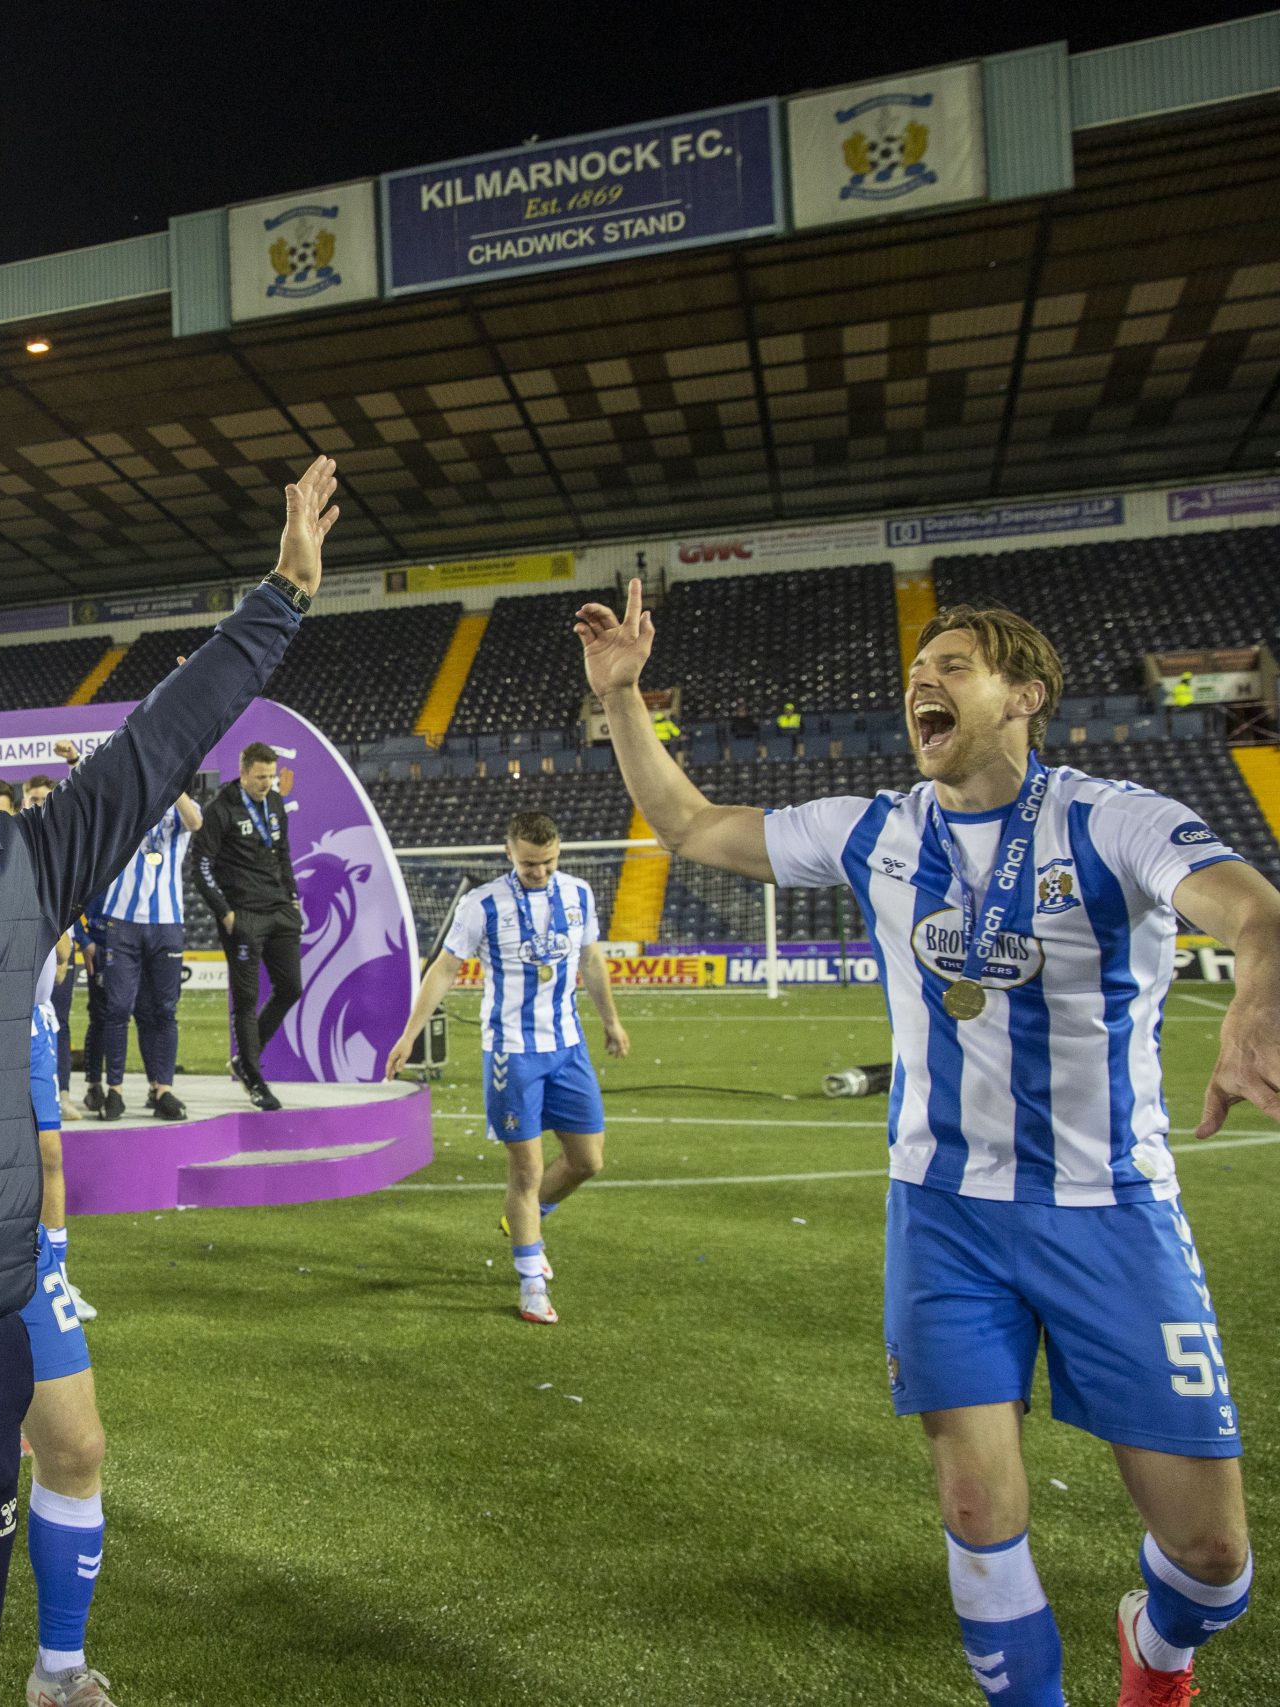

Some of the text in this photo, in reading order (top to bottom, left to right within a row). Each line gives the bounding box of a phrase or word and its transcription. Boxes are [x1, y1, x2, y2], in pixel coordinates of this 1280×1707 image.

[420, 128, 734, 212] KILMARNOCK F.C.
[523, 183, 625, 219] Est. 1869
[467, 210, 687, 266] CHADWICK STAND
[1018, 773, 1048, 823] cinch
[994, 837, 1029, 890] cinch
[974, 905, 1006, 960] cinch
[605, 959, 699, 976] OWIE
[619, 976, 699, 985] LIMITED
[729, 958, 880, 983] HAMILTO
[940, 959, 963, 970] THE
